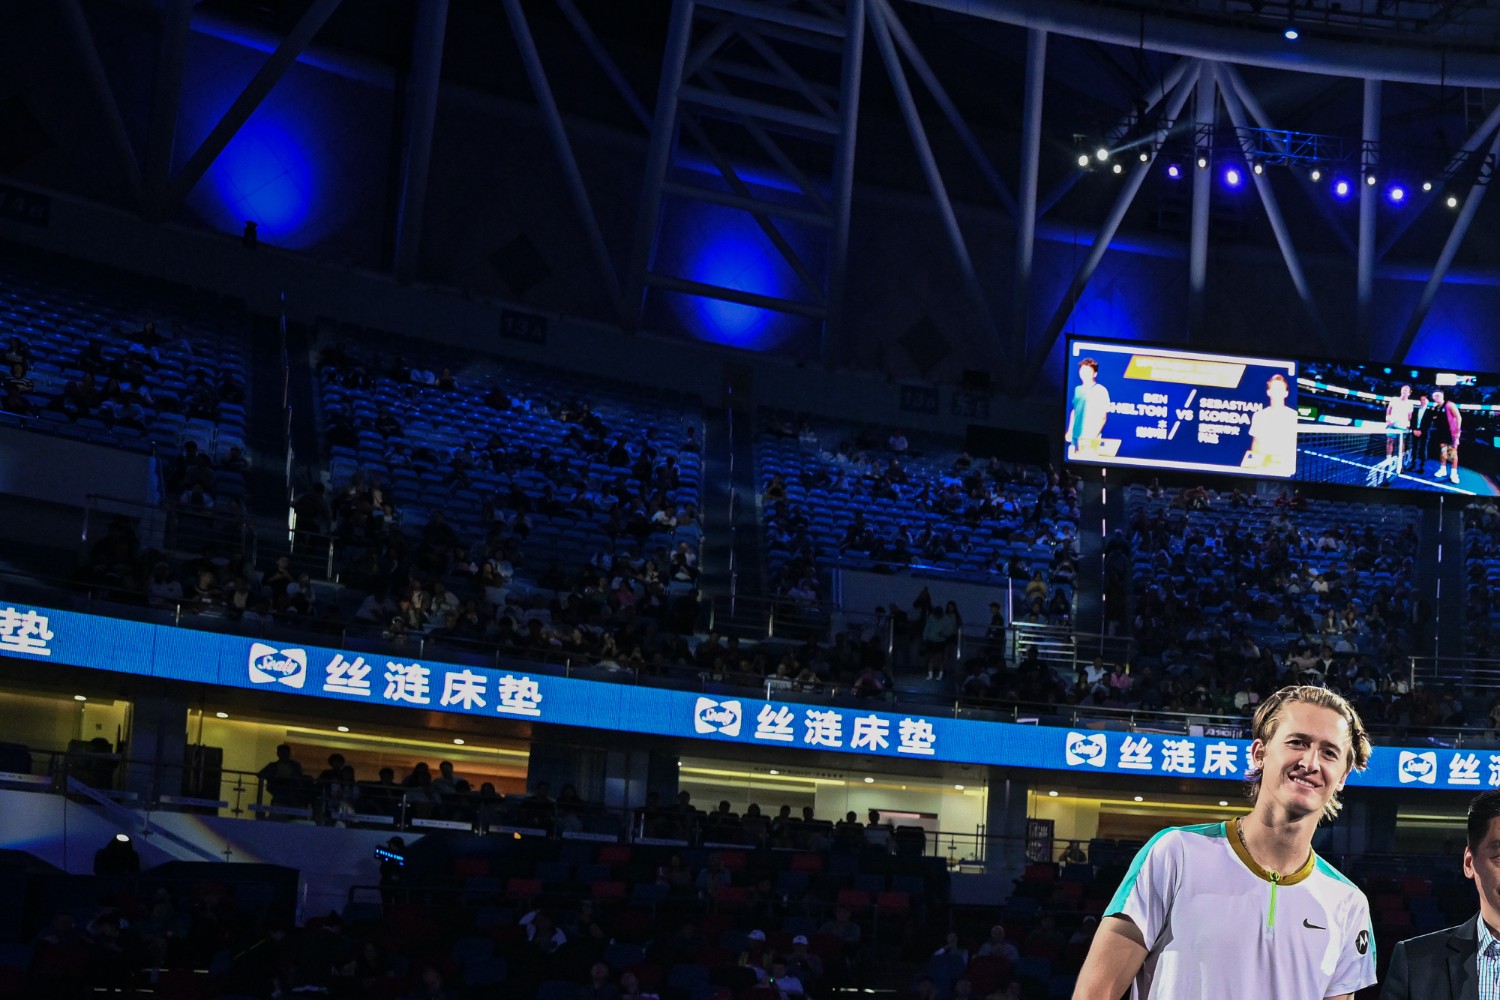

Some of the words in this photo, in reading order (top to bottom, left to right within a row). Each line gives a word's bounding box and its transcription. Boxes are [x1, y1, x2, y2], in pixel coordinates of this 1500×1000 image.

[1143, 392, 1168, 405] BEN
[1199, 397, 1263, 413] SEBASTIAN
[1108, 401, 1168, 418] HELTON
[1175, 408, 1194, 421] VS
[1199, 409, 1251, 425] KORDA
[323, 653, 543, 717] 丝涟床垫
[754, 703, 937, 755] 丝涟床垫
[1118, 736, 1253, 776] 丝涟床
